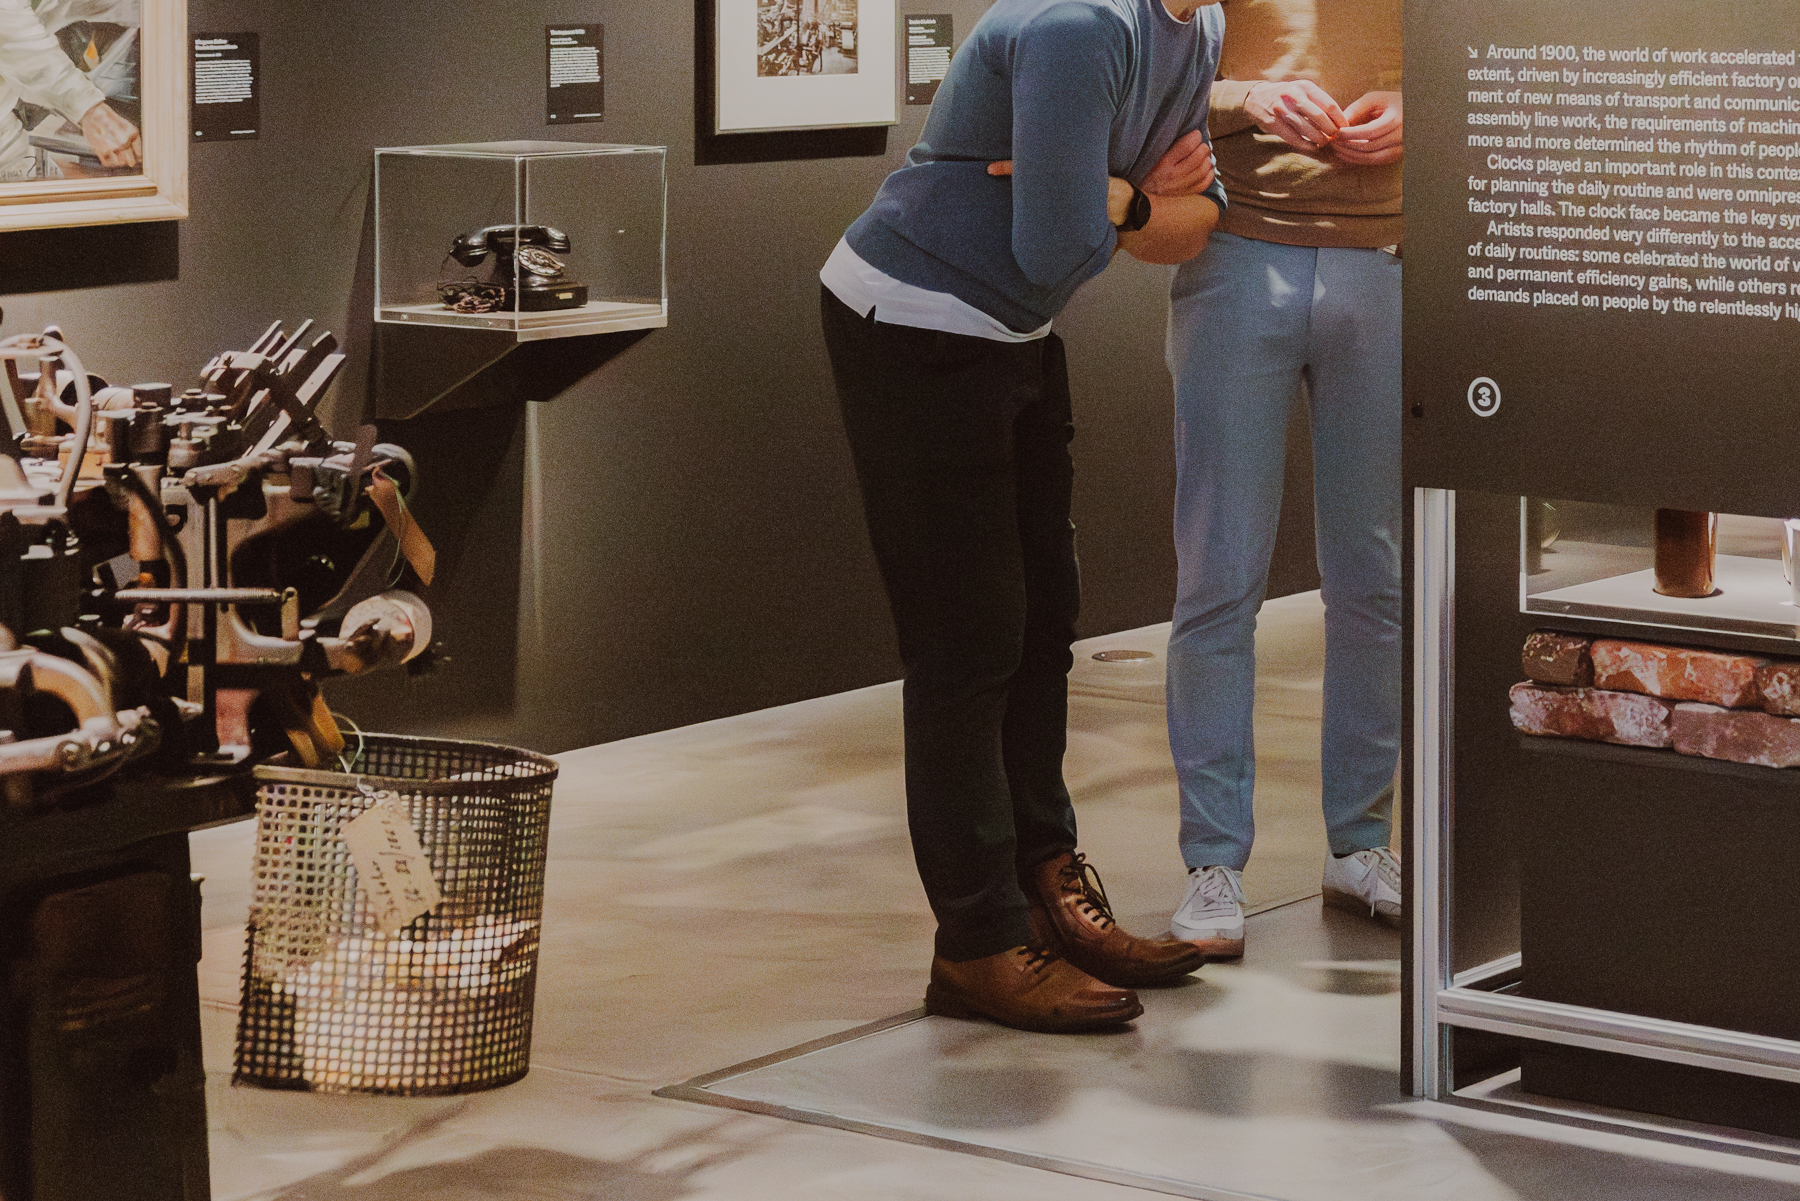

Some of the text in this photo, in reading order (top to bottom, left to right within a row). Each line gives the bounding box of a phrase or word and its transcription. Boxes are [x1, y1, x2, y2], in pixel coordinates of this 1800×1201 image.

[1487, 43, 1537, 59] Around
[1540, 45, 1579, 62] 1900,
[1582, 45, 1606, 61] the
[1609, 46, 1649, 62] world
[1652, 47, 1667, 62] of
[1670, 48, 1707, 63] work
[1710, 49, 1795, 66] accelerated
[1468, 66, 1514, 83] extent,
[1518, 67, 1559, 82] driven
[1563, 68, 1579, 86] by
[1583, 69, 1666, 89] increasingly
[1669, 70, 1728, 86] efficient
[1731, 71, 1784, 91] factory
[1468, 89, 1503, 103] ment
[1507, 89, 1521, 103] of
[1524, 93, 1552, 104] new
[1557, 93, 1602, 106] means
[1605, 91, 1620, 106] of
[1623, 93, 1690, 111] transport
[1694, 94, 1720, 109] and
[1467, 111, 1531, 130] assembly
[1535, 112, 1558, 127] line
[1562, 114, 1601, 130] work,
[1604, 114, 1627, 129] the
[1632, 116, 1726, 133] requirements
[1730, 117, 1745, 133] of
[1468, 135, 1503, 147] more
[1506, 133, 1531, 148] and
[1536, 137, 1571, 149] more
[1574, 136, 1653, 152] determined
[1657, 138, 1681, 153] the
[1685, 139, 1736, 158] rhythm
[1740, 141, 1755, 156] of
[1468, 285, 1530, 303] demands
[1533, 289, 1578, 307] placed
[1581, 294, 1599, 307] on
[1603, 294, 1649, 312] people
[1653, 295, 1670, 314] by
[1672, 296, 1697, 313] the
[1700, 299, 1782, 321] relentlessly
[1477, 386, 1491, 407] 3
